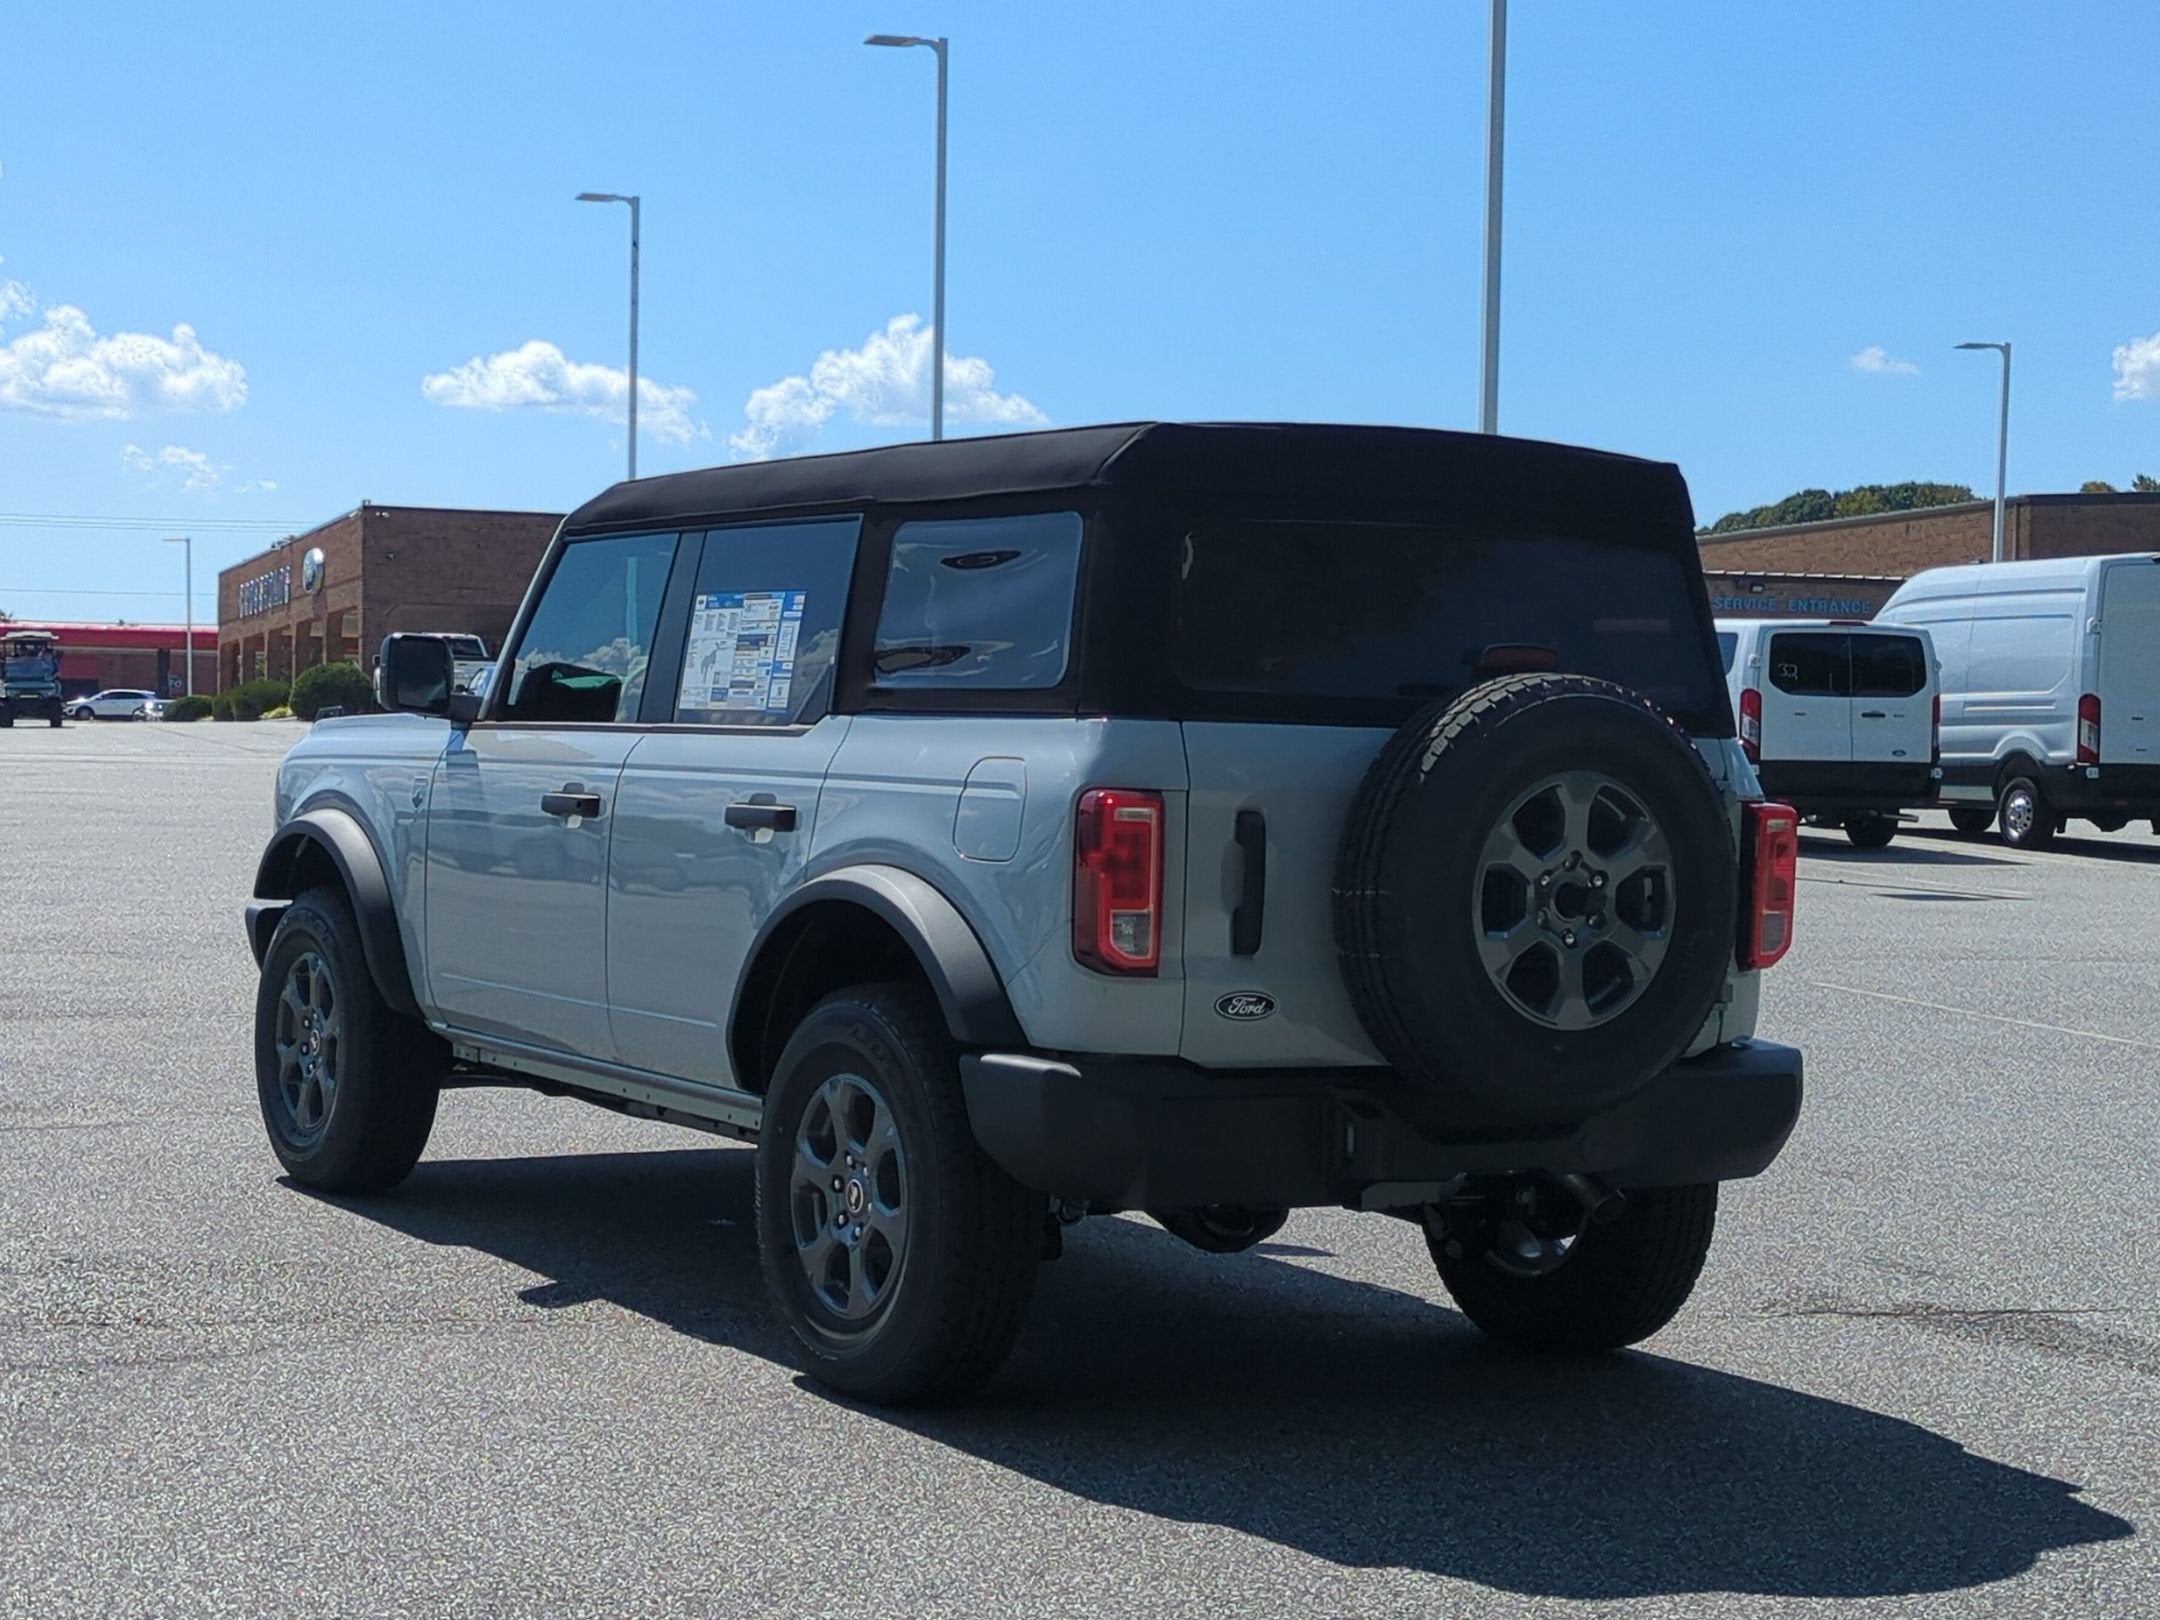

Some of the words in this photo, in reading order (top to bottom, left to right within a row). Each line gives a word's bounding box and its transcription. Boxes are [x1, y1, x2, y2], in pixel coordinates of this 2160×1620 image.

[1712, 595, 1777, 612] SERVICE
[1787, 598, 1871, 614] ENTRANCE
[1226, 995, 1268, 1016] Ford
